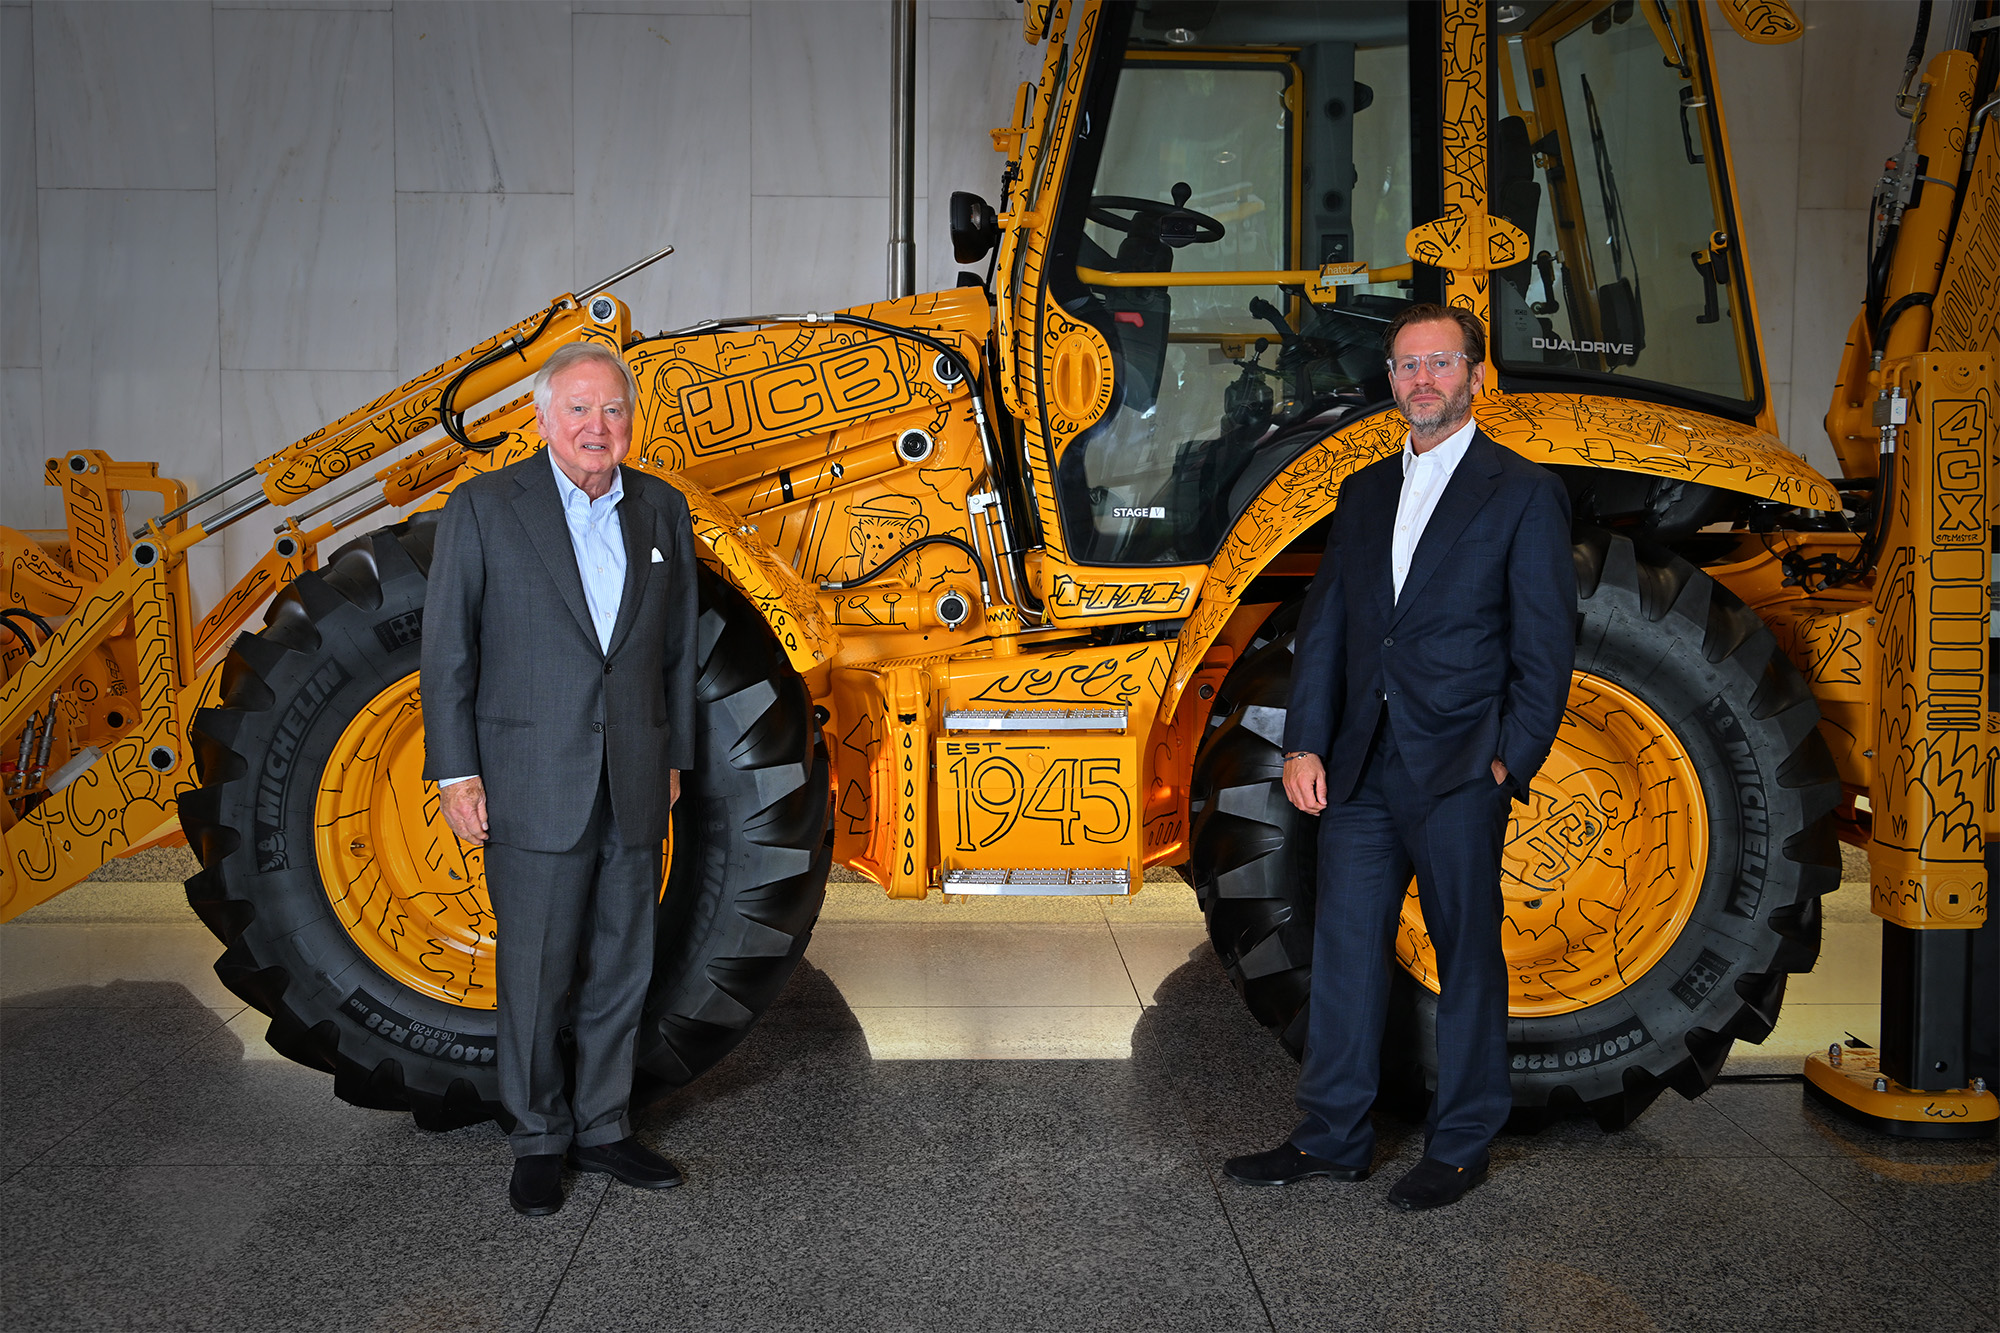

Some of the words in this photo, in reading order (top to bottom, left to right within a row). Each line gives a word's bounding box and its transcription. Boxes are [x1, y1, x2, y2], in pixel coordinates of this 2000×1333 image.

[1320, 264, 1367, 275] hatch
[1532, 337, 1634, 355] DUALDRIVE
[686, 344, 901, 449] JCB
[1937, 404, 1983, 531] 4CX
[1113, 508, 1149, 517] STAGE
[256, 658, 344, 828] MICHELIN
[946, 742, 1002, 756] EST
[949, 756, 1131, 851] 1945
[1724, 740, 1768, 916] MICHELIN
[350, 998, 369, 1014] IND
[1678, 986, 1697, 1004] Line
[365, 1012, 411, 1044] R28
[410, 1034, 496, 1063] 440/80
[1511, 1053, 1560, 1070] R28
[1565, 1028, 1644, 1067] 440/80
